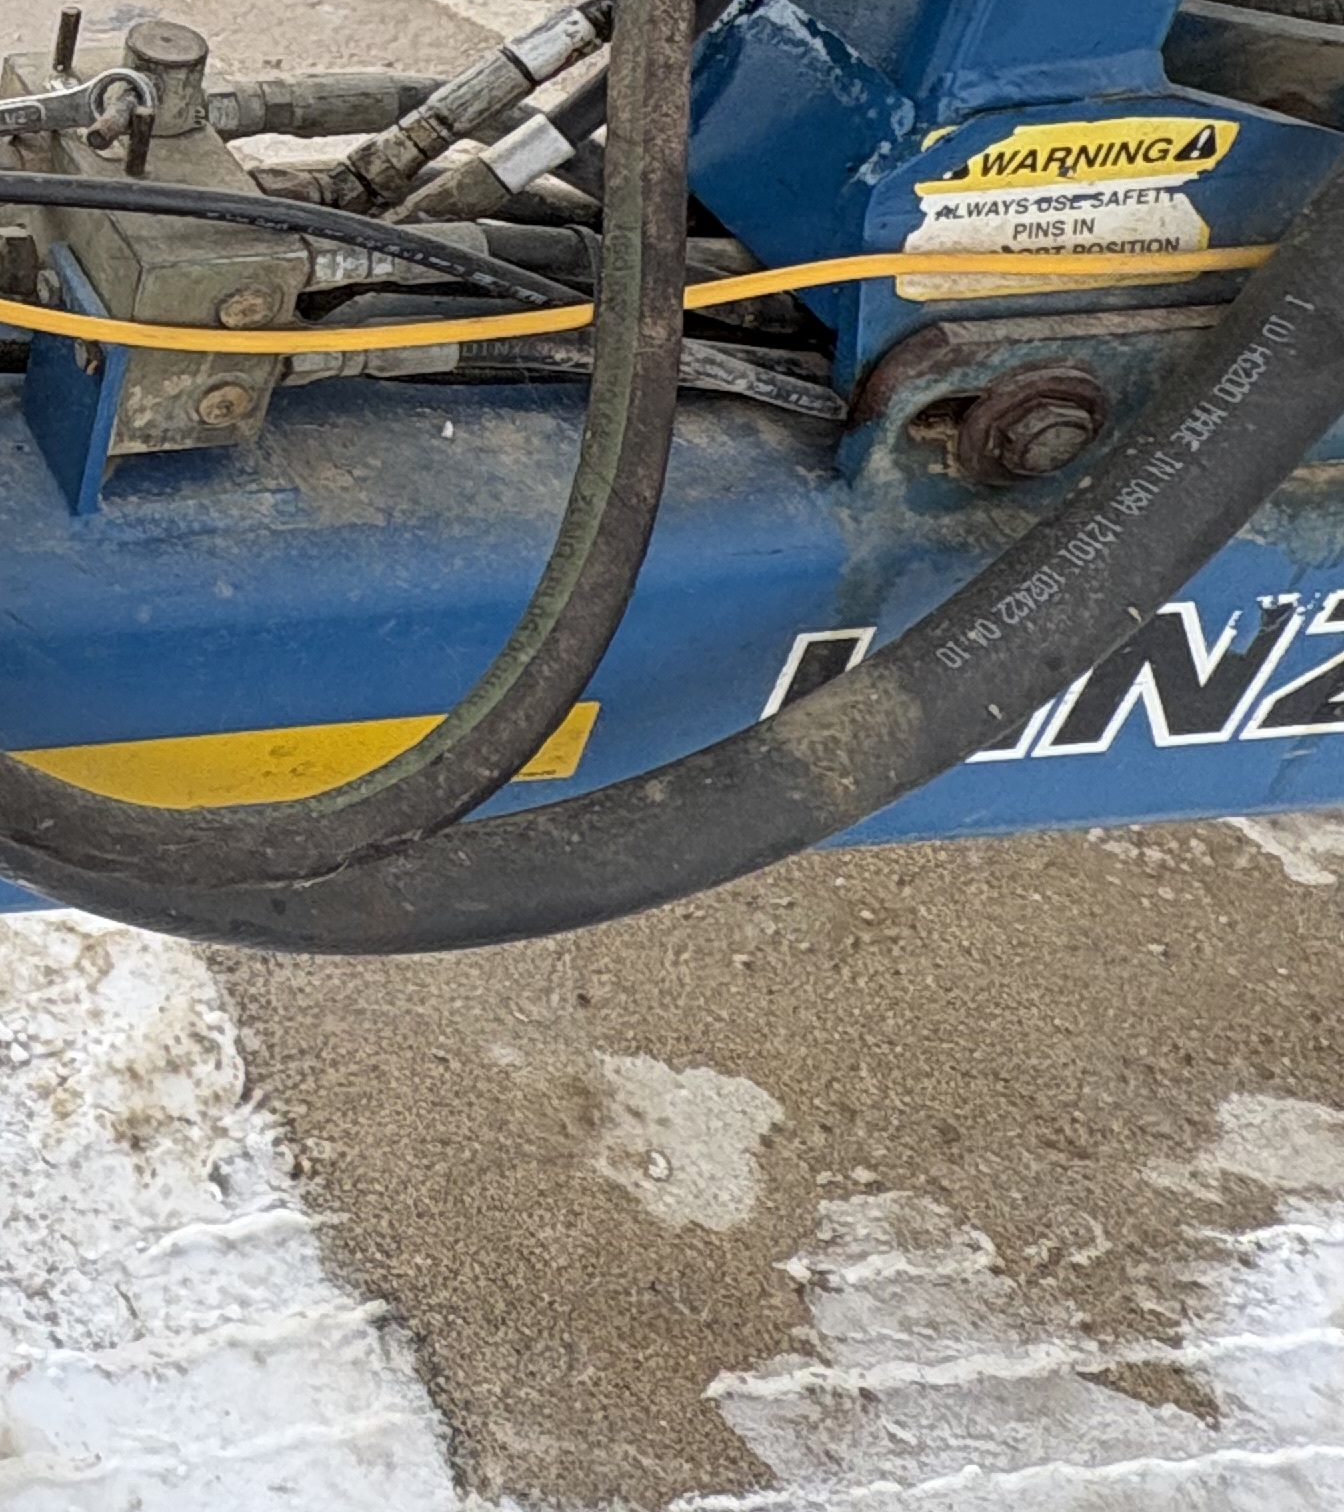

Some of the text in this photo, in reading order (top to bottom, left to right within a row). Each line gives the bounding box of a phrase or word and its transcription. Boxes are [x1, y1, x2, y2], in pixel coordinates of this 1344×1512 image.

[979, 137, 1175, 179] WARNING
[934, 196, 1030, 222] ALWAYS
[1012, 216, 1097, 242] PINS IN
[1169, 400, 1230, 453] MADE
[1143, 450, 1185, 481] IN
[1109, 478, 1161, 516] USA
[1056, 514, 1124, 567] 12101
